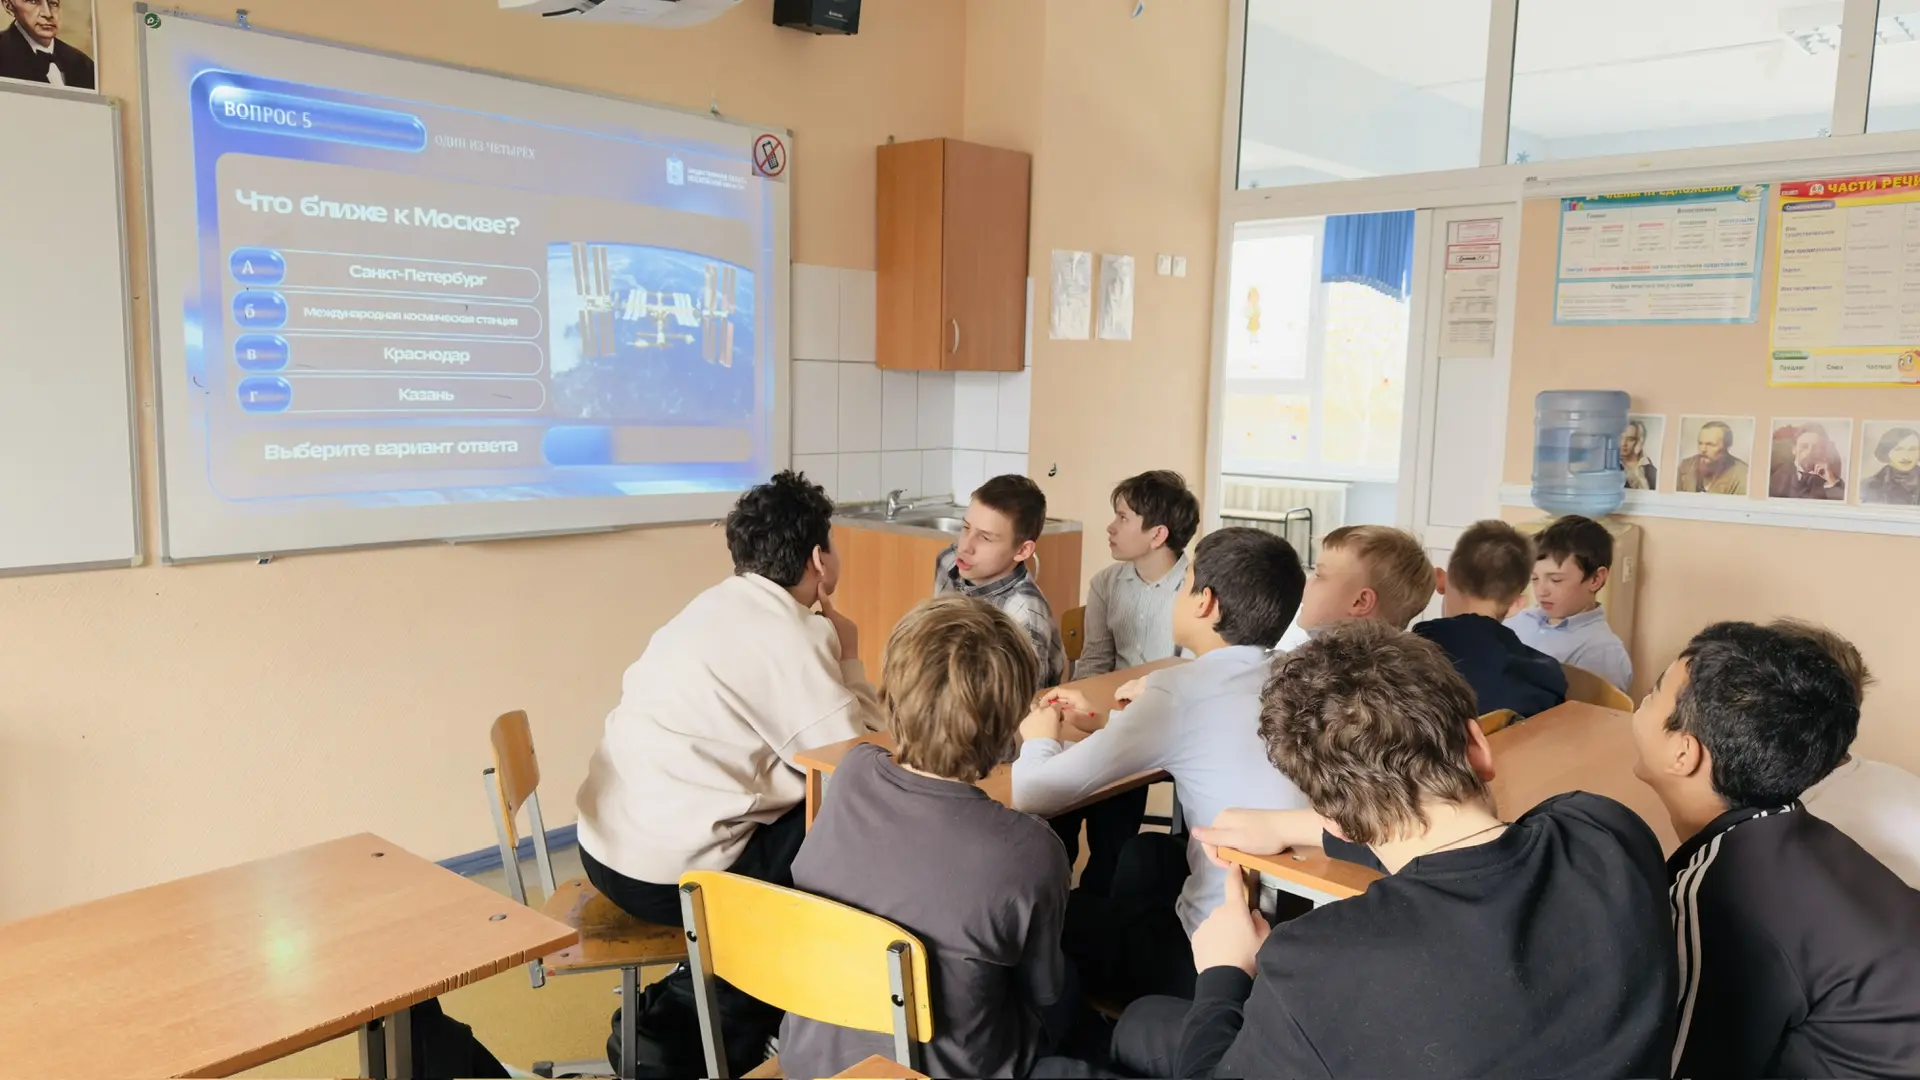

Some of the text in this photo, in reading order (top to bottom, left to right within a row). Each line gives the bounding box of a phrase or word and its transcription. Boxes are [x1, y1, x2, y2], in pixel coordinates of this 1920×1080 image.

[224, 101, 313, 128] ВОПРОС 5
[434, 134, 466, 149] ОДИН
[1827, 179, 1877, 193] ЧАСТИ
[235, 189, 520, 236] Что ближе к Москве?
[241, 260, 255, 276] А
[349, 264, 488, 288] Санкт-Петербург
[383, 345, 471, 364] Краснодар
[398, 386, 455, 402] Казань
[264, 437, 519, 461] Выберите вариант ответа
